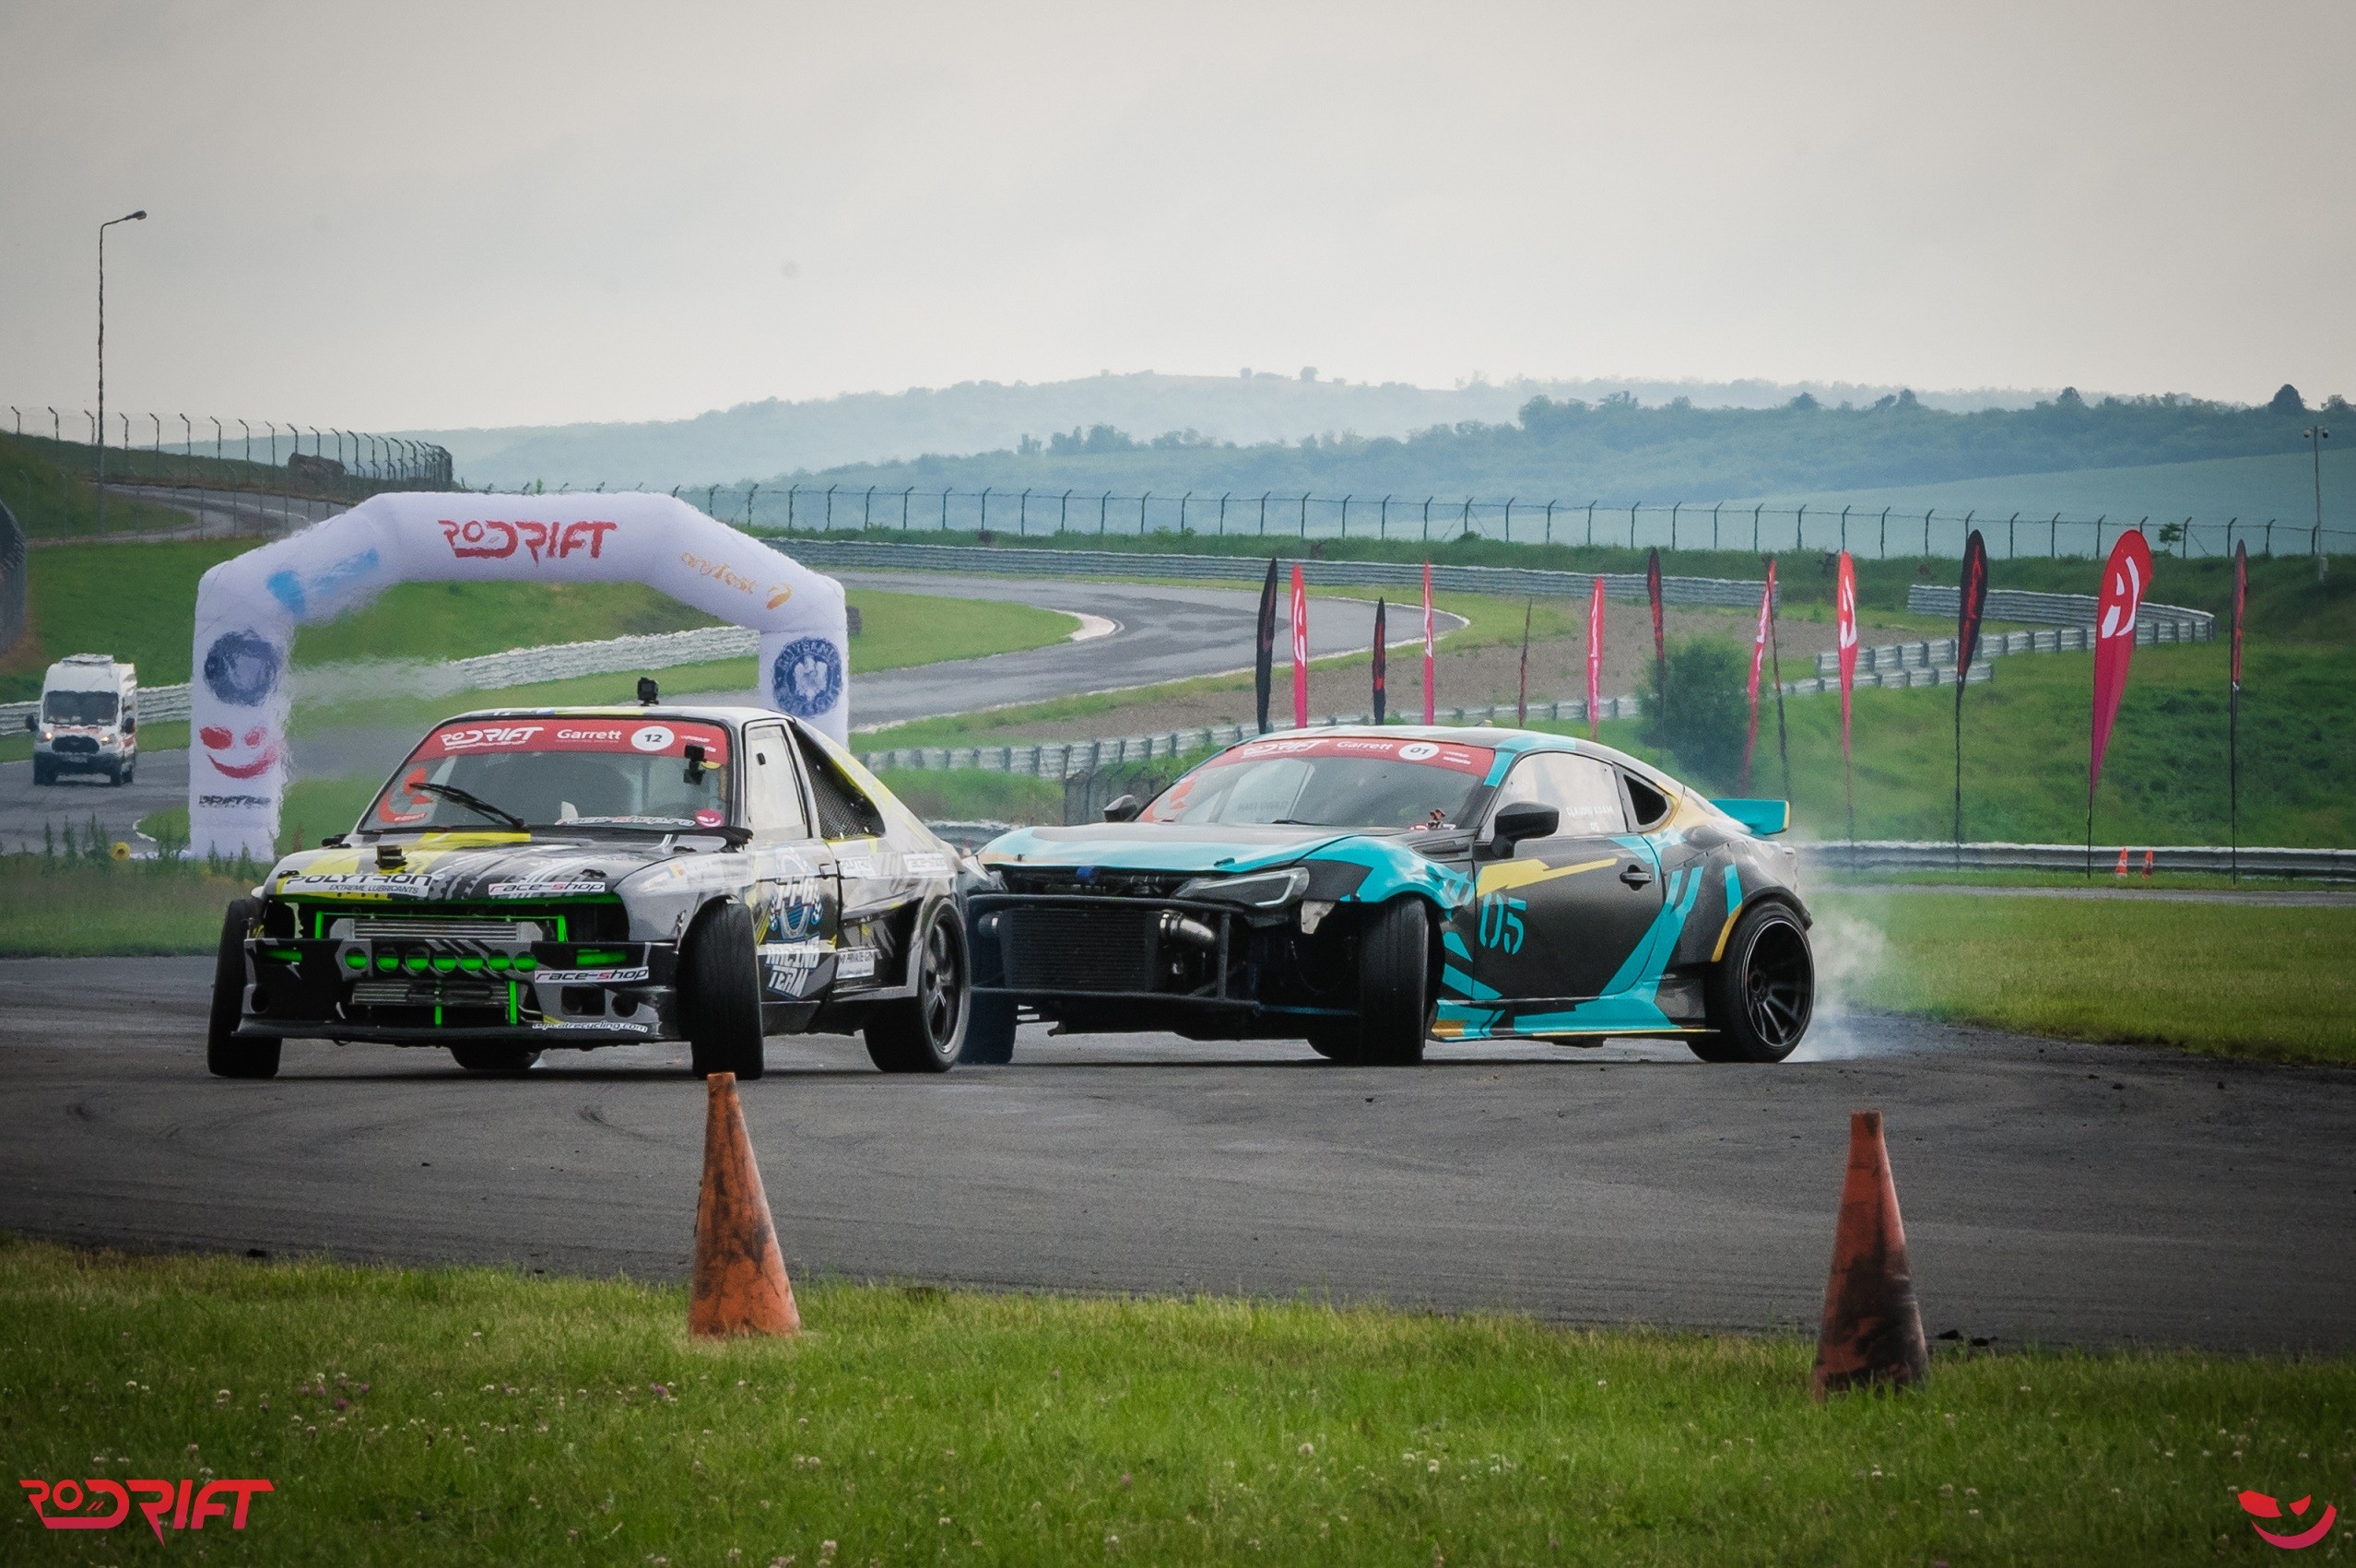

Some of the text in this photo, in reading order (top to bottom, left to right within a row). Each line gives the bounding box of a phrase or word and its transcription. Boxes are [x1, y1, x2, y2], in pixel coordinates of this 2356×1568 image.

[557, 729, 622, 740] Garrett
[644, 734, 663, 743] 12
[1337, 740, 1394, 751] Garrett
[1409, 747, 1429, 755] 01
[286, 875, 434, 886] POLYTRON
[368, 884, 419, 895] LUBRICANTS
[489, 882, 605, 893] race-shop
[1479, 892, 1526, 955] 05
[536, 970, 648, 981] race-shop
